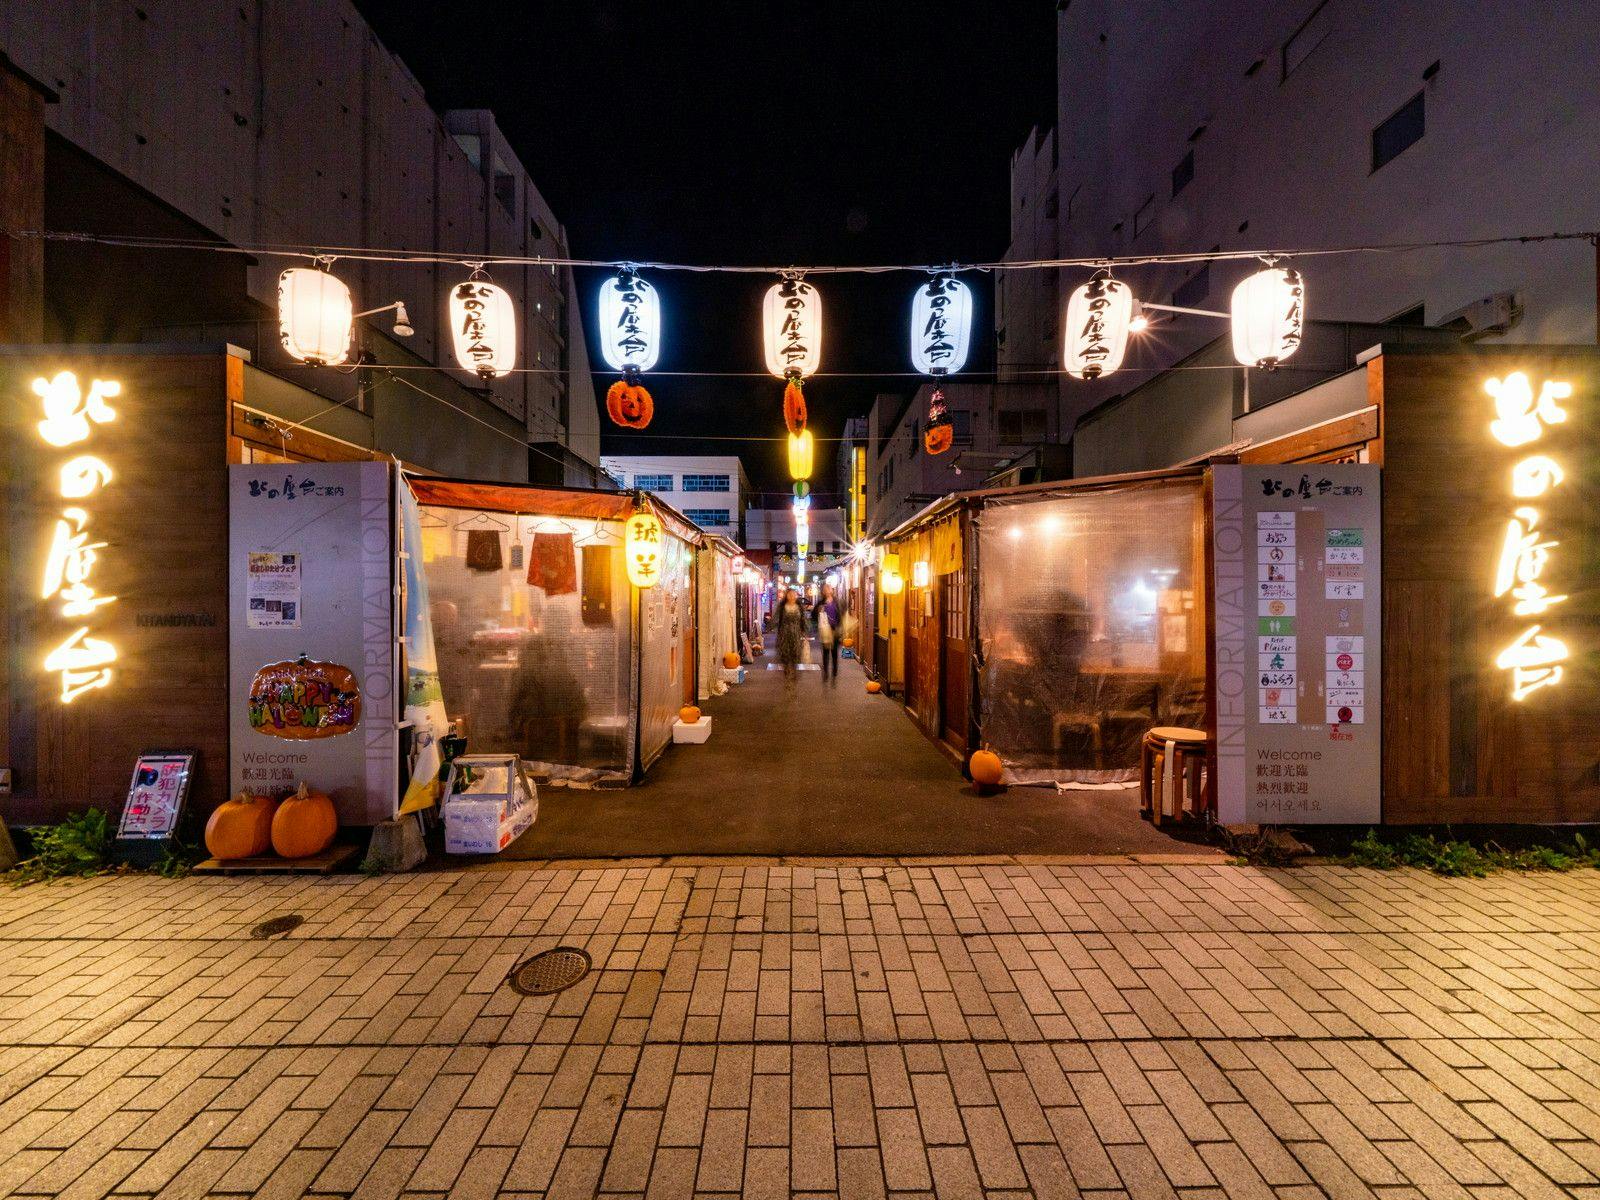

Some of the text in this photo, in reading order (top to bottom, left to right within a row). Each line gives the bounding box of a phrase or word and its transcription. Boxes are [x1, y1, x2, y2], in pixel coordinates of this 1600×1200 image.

[456, 283, 493, 361] 北の屋台
[614, 274, 650, 356] 北の屋台
[777, 278, 811, 365] 北の屋台
[925, 277, 959, 363] 北の屋台
[1080, 279, 1121, 364] 北の屋台
[31, 371, 121, 704] 北の屋台
[1483, 371, 1573, 702] 北の屋台
[361, 497, 392, 760] INFORMATION
[1215, 498, 1245, 757] INFORMATION
[242, 752, 308, 764] Welcome
[1256, 749, 1322, 760] Welcome
